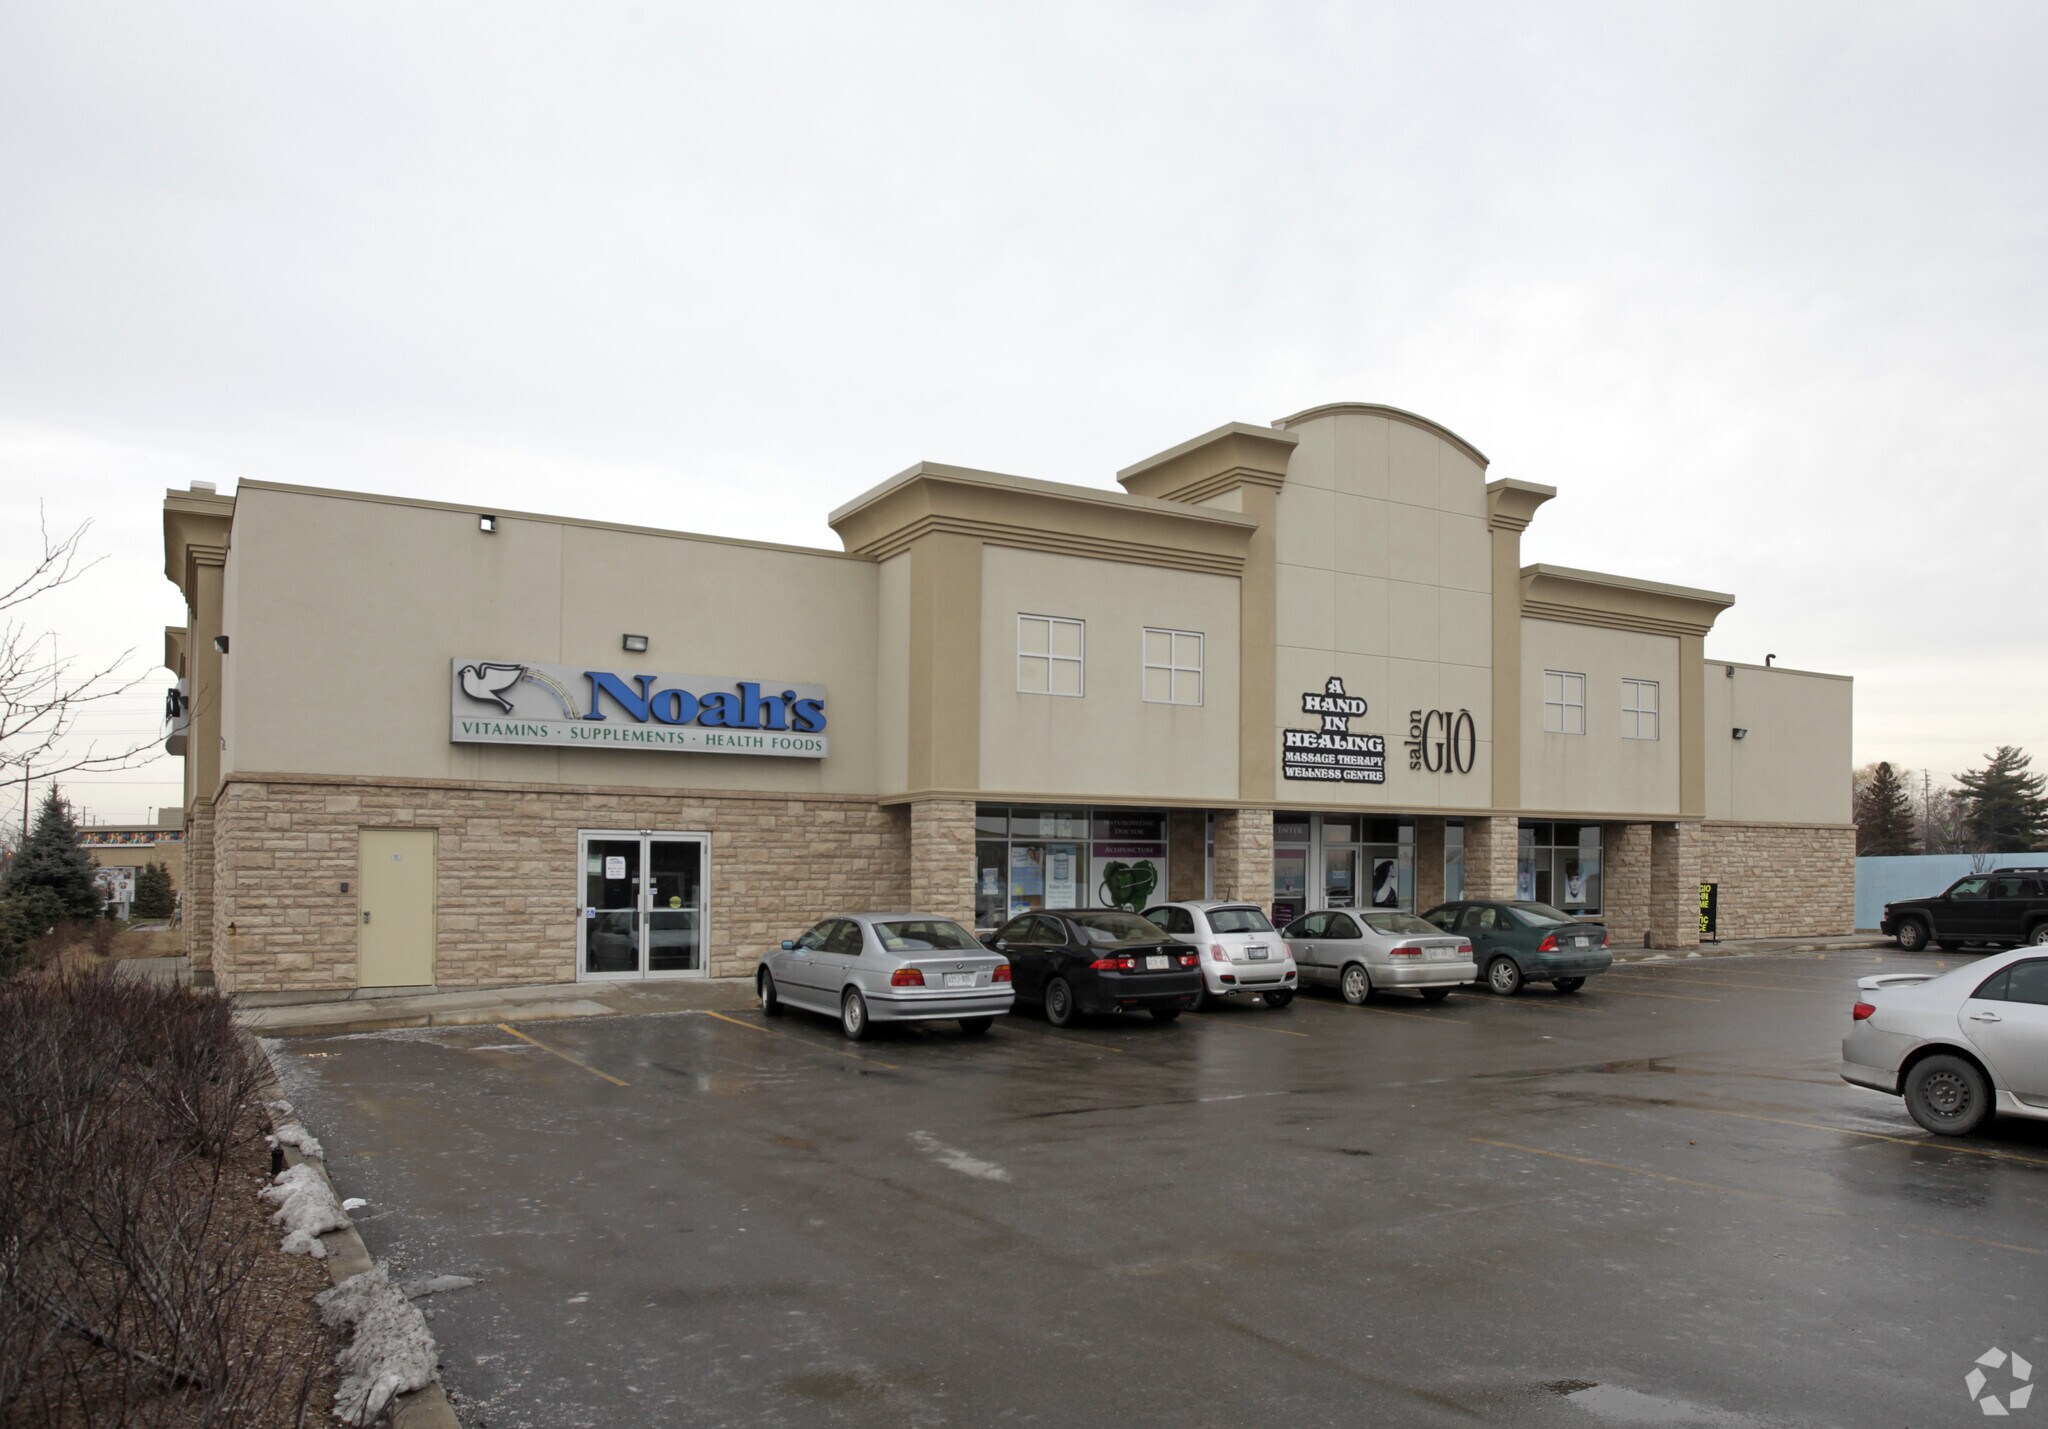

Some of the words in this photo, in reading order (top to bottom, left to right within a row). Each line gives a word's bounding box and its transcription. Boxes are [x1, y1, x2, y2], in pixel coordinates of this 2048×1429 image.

[1328, 679, 1344, 694] A
[583, 671, 827, 733] Noah's
[1304, 695, 1366, 714] HAND
[1324, 716, 1348, 731] IN
[462, 721, 549, 738] VITAMINS
[570, 726, 685, 745] SUPPLEMENTS
[705, 733, 764, 749] HEALTH
[772, 736, 823, 752] FOODS
[1285, 732, 1383, 752] HEALING
[1404, 709, 1422, 771] salon
[1285, 752, 1336, 764] MASSAGE
[1337, 754, 1383, 767] THERAPY
[1285, 767, 1342, 779] WELLNESS
[1343, 769, 1383, 781] CENTRE
